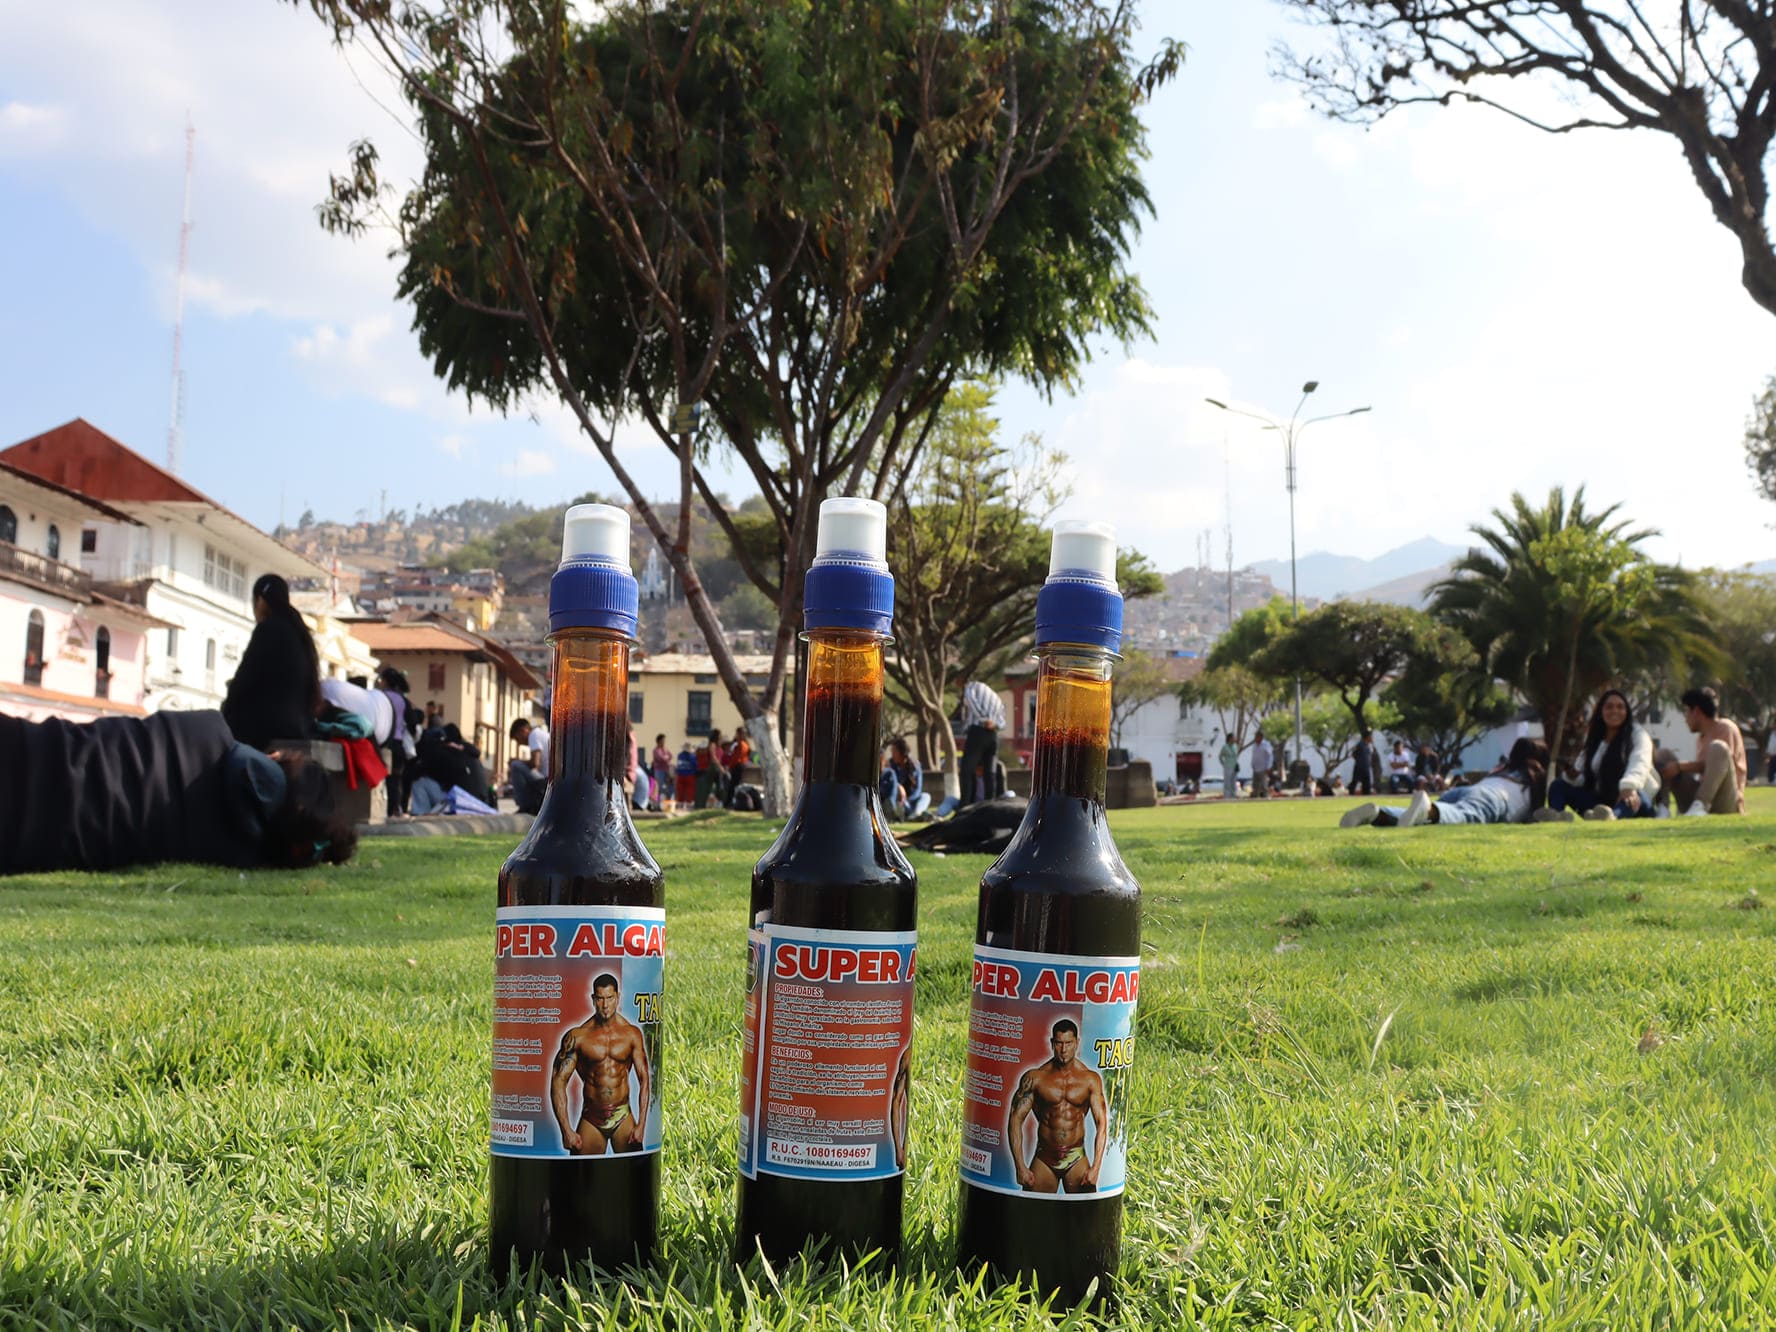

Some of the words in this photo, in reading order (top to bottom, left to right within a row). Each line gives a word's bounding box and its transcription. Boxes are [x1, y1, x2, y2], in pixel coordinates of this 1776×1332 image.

[496, 924, 557, 958] PER
[774, 943, 901, 984] SUPER
[775, 983, 825, 998] PROPIEDADES:
[771, 1046, 813, 1061] BENEFICIOS:
[768, 1102, 788, 1114] MODO
[771, 1142, 802, 1156] R.U.C.
[806, 1146, 872, 1159] 10801694697
